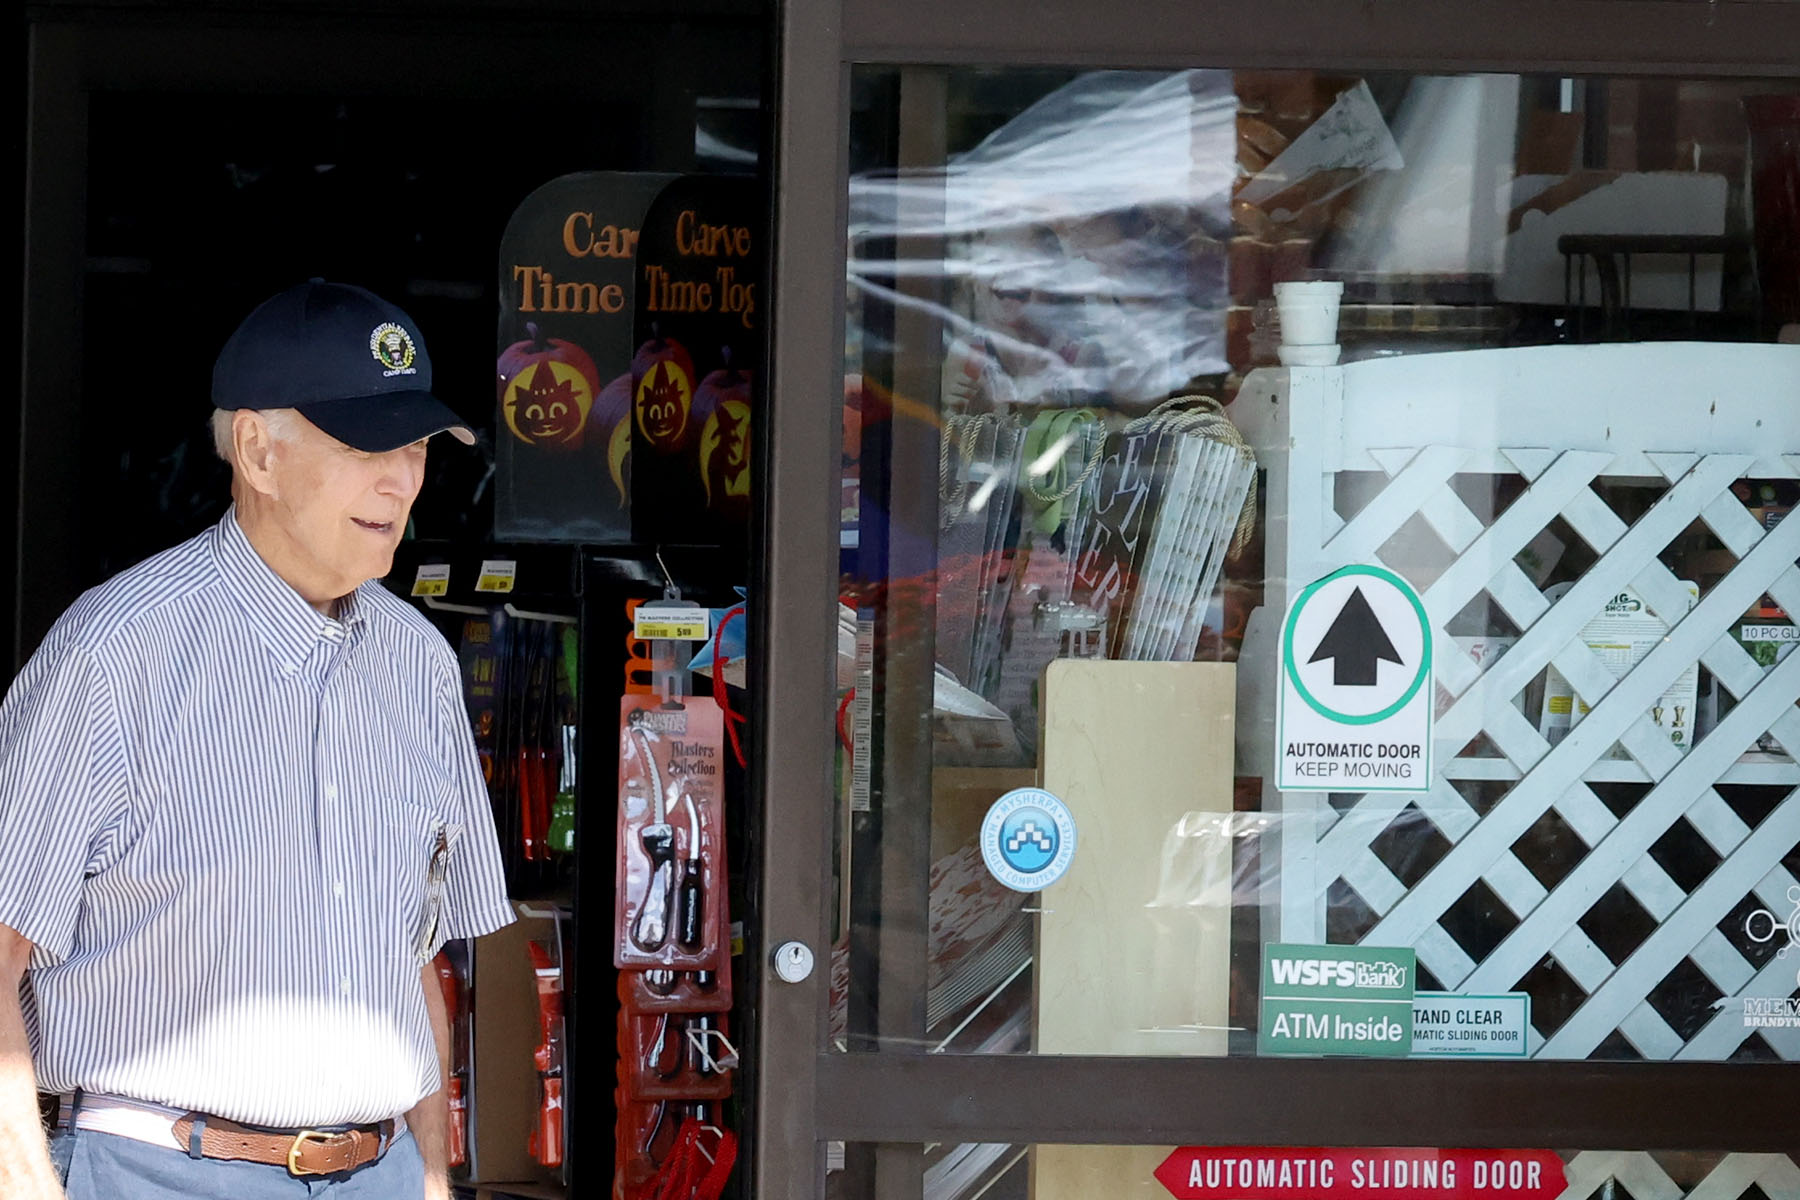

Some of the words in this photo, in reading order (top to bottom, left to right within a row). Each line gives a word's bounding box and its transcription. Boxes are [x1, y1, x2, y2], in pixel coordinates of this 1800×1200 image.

[675, 210, 750, 257] Carve
[513, 265, 625, 314] Time
[644, 265, 713, 312] Time
[1744, 628, 1758, 639] 10
[1761, 628, 1778, 639] PC
[1286, 742, 1375, 758] AUTOMATIC
[1378, 744, 1421, 759] DOOR
[1295, 762, 1338, 776] KEEP
[1344, 763, 1412, 778] MOVING
[1000, 794, 1058, 815] MYSHERPA
[986, 823, 1006, 873] MANAGED
[1006, 868, 1057, 886] COMPUTER
[1056, 820, 1073, 870] SERVICES
[1270, 958, 1356, 987] WSFS
[1357, 963, 1401, 987] bank
[1272, 1012, 1329, 1040] ATM
[1336, 1014, 1403, 1042] Inside
[1456, 1010, 1503, 1025] CLEAR
[1448, 1030, 1489, 1041] SLIDING
[1490, 1030, 1519, 1042] DOOR
[1188, 1157, 1336, 1190] AUTOMATIC
[1350, 1159, 1457, 1190] SLIDING
[1472, 1160, 1543, 1191] DOOR
